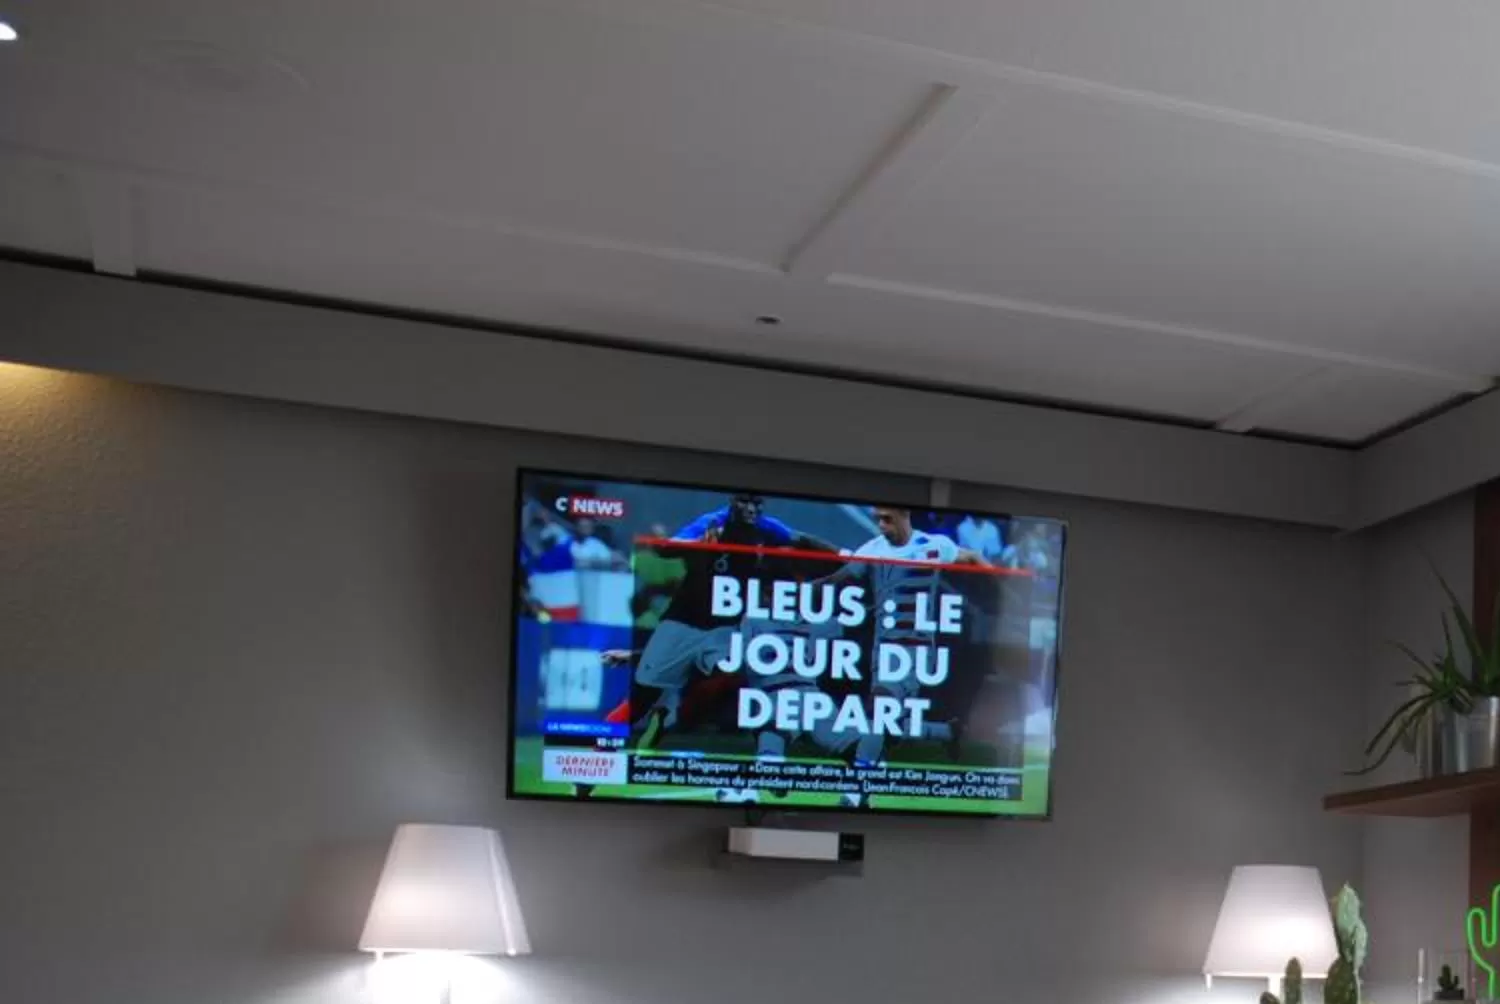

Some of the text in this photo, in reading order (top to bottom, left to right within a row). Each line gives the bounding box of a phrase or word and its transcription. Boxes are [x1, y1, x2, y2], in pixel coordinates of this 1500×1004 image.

[555, 497, 623, 516] C NEWS
[711, 575, 963, 633] BLEUS : LE
[717, 632, 949, 686] JOUR DU
[738, 687, 931, 737] DEPART
[561, 766, 609, 777] MINUTE
